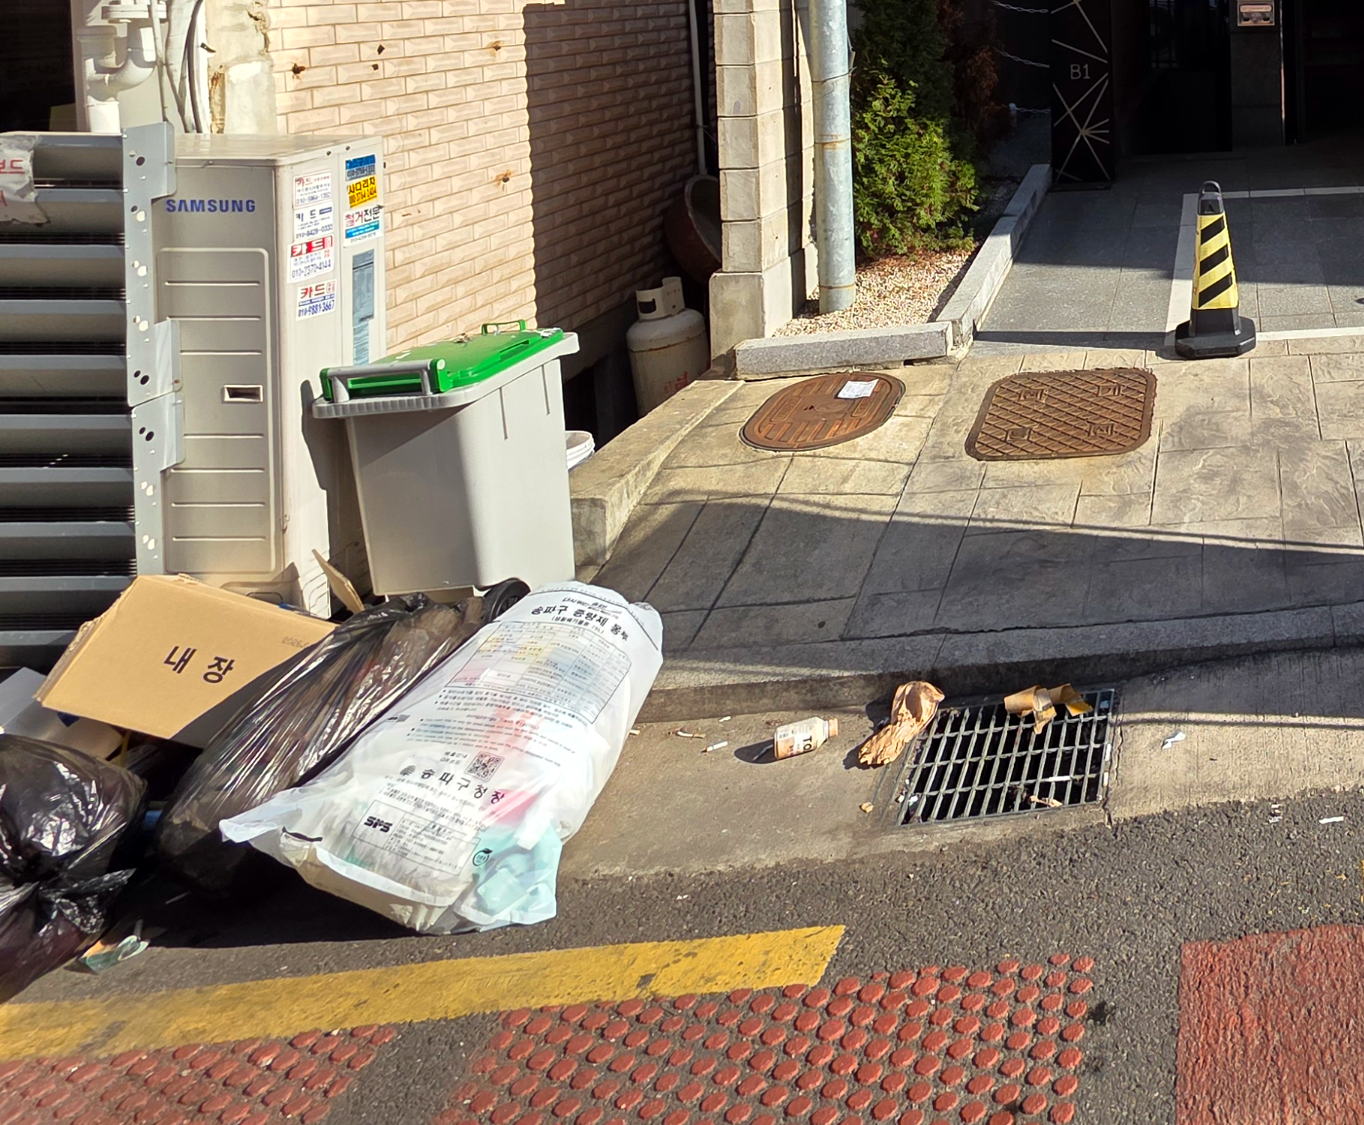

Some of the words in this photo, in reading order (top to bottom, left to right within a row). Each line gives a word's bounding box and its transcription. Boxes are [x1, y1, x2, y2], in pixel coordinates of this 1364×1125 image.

[1070, 63, 1091, 80] B1
[166, 198, 256, 213] SAMSUNG
[345, 206, 381, 227] 철거전문
[291, 238, 325, 256] 카드
[300, 282, 326, 299] 카드
[420, 767, 506, 806] 송파구청장
